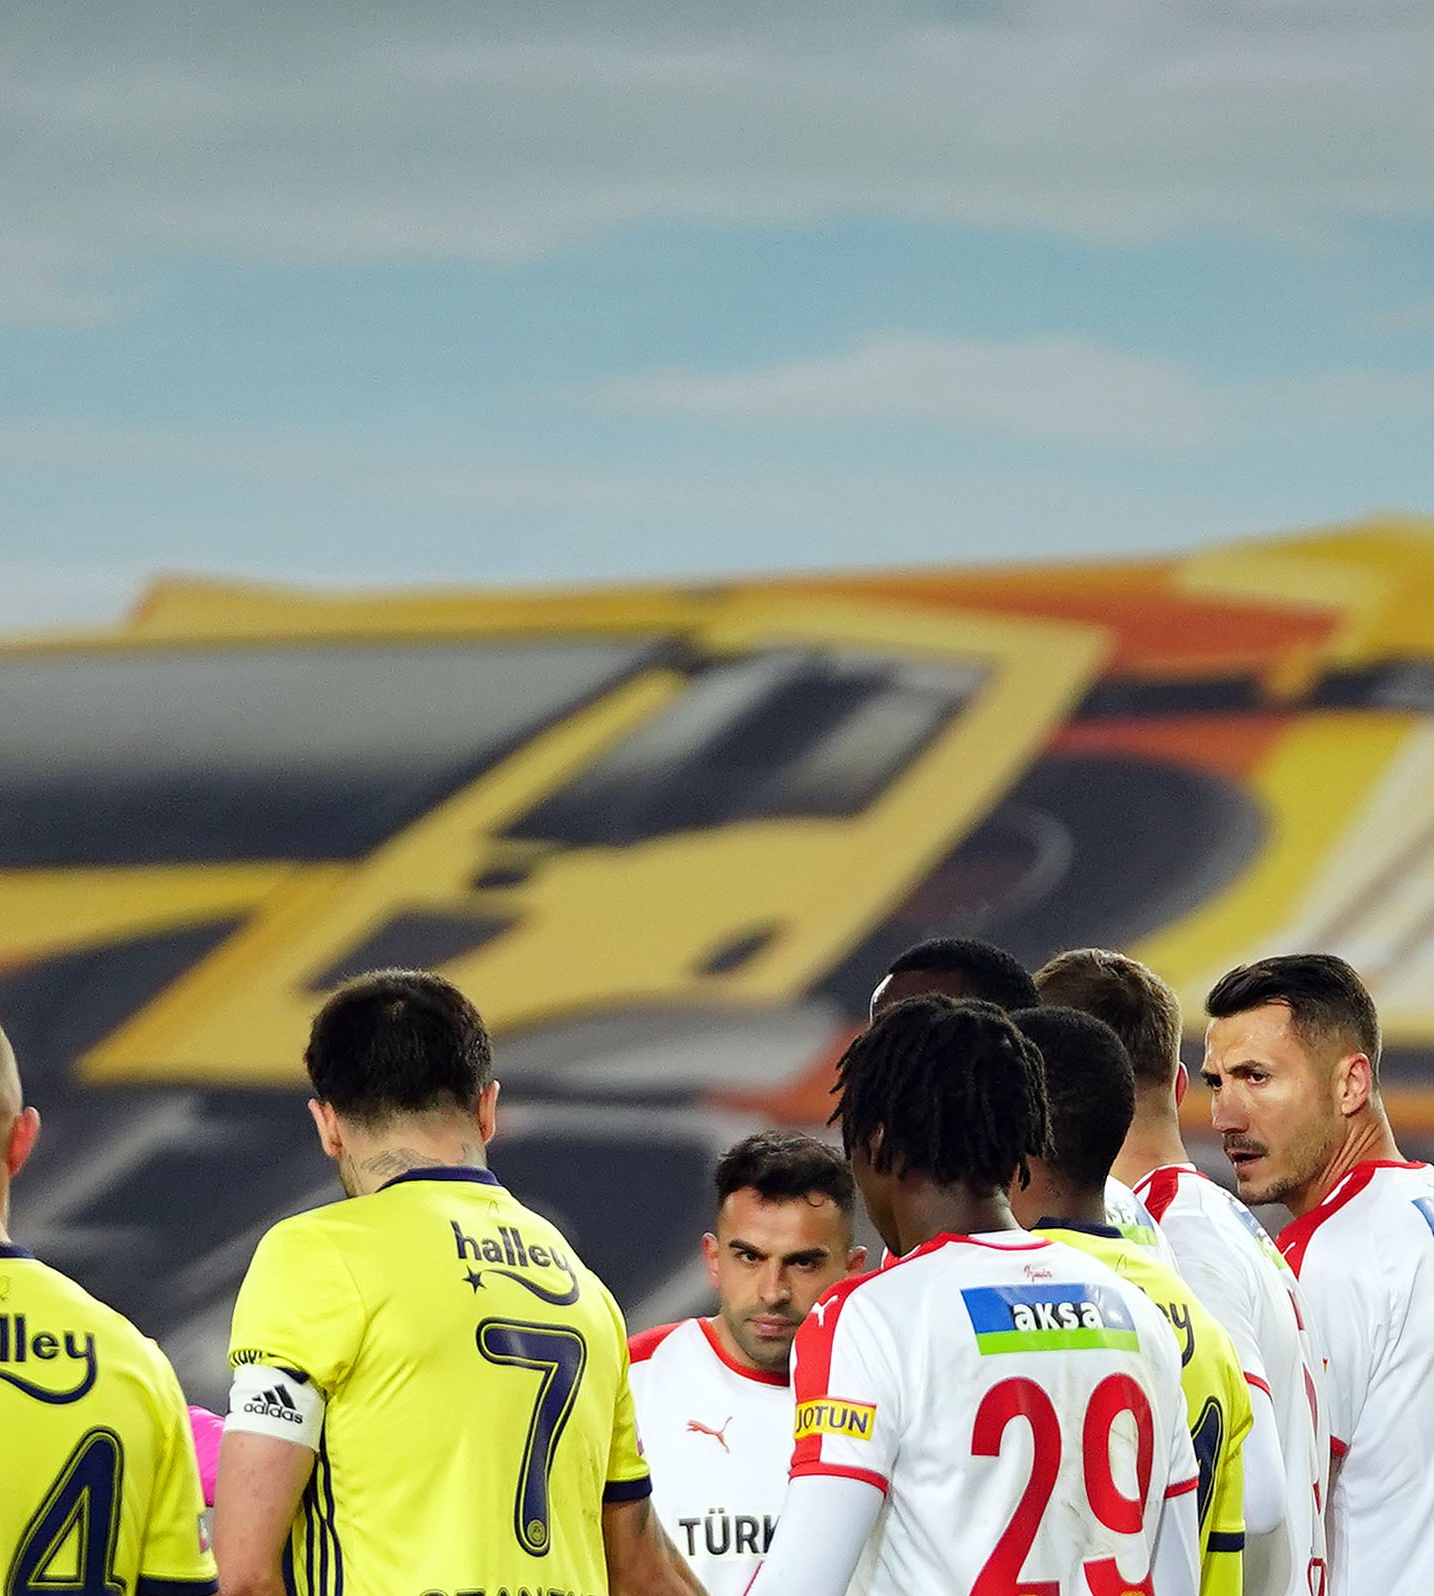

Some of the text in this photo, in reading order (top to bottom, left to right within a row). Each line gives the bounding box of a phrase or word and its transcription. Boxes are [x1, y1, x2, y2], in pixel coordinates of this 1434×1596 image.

[452, 1219, 579, 1305] halley
[1013, 1301, 1105, 1332] aksa
[244, 1402, 303, 1425] adidas
[796, 1405, 869, 1434] JOTUN
[475, 1317, 588, 1557] 7
